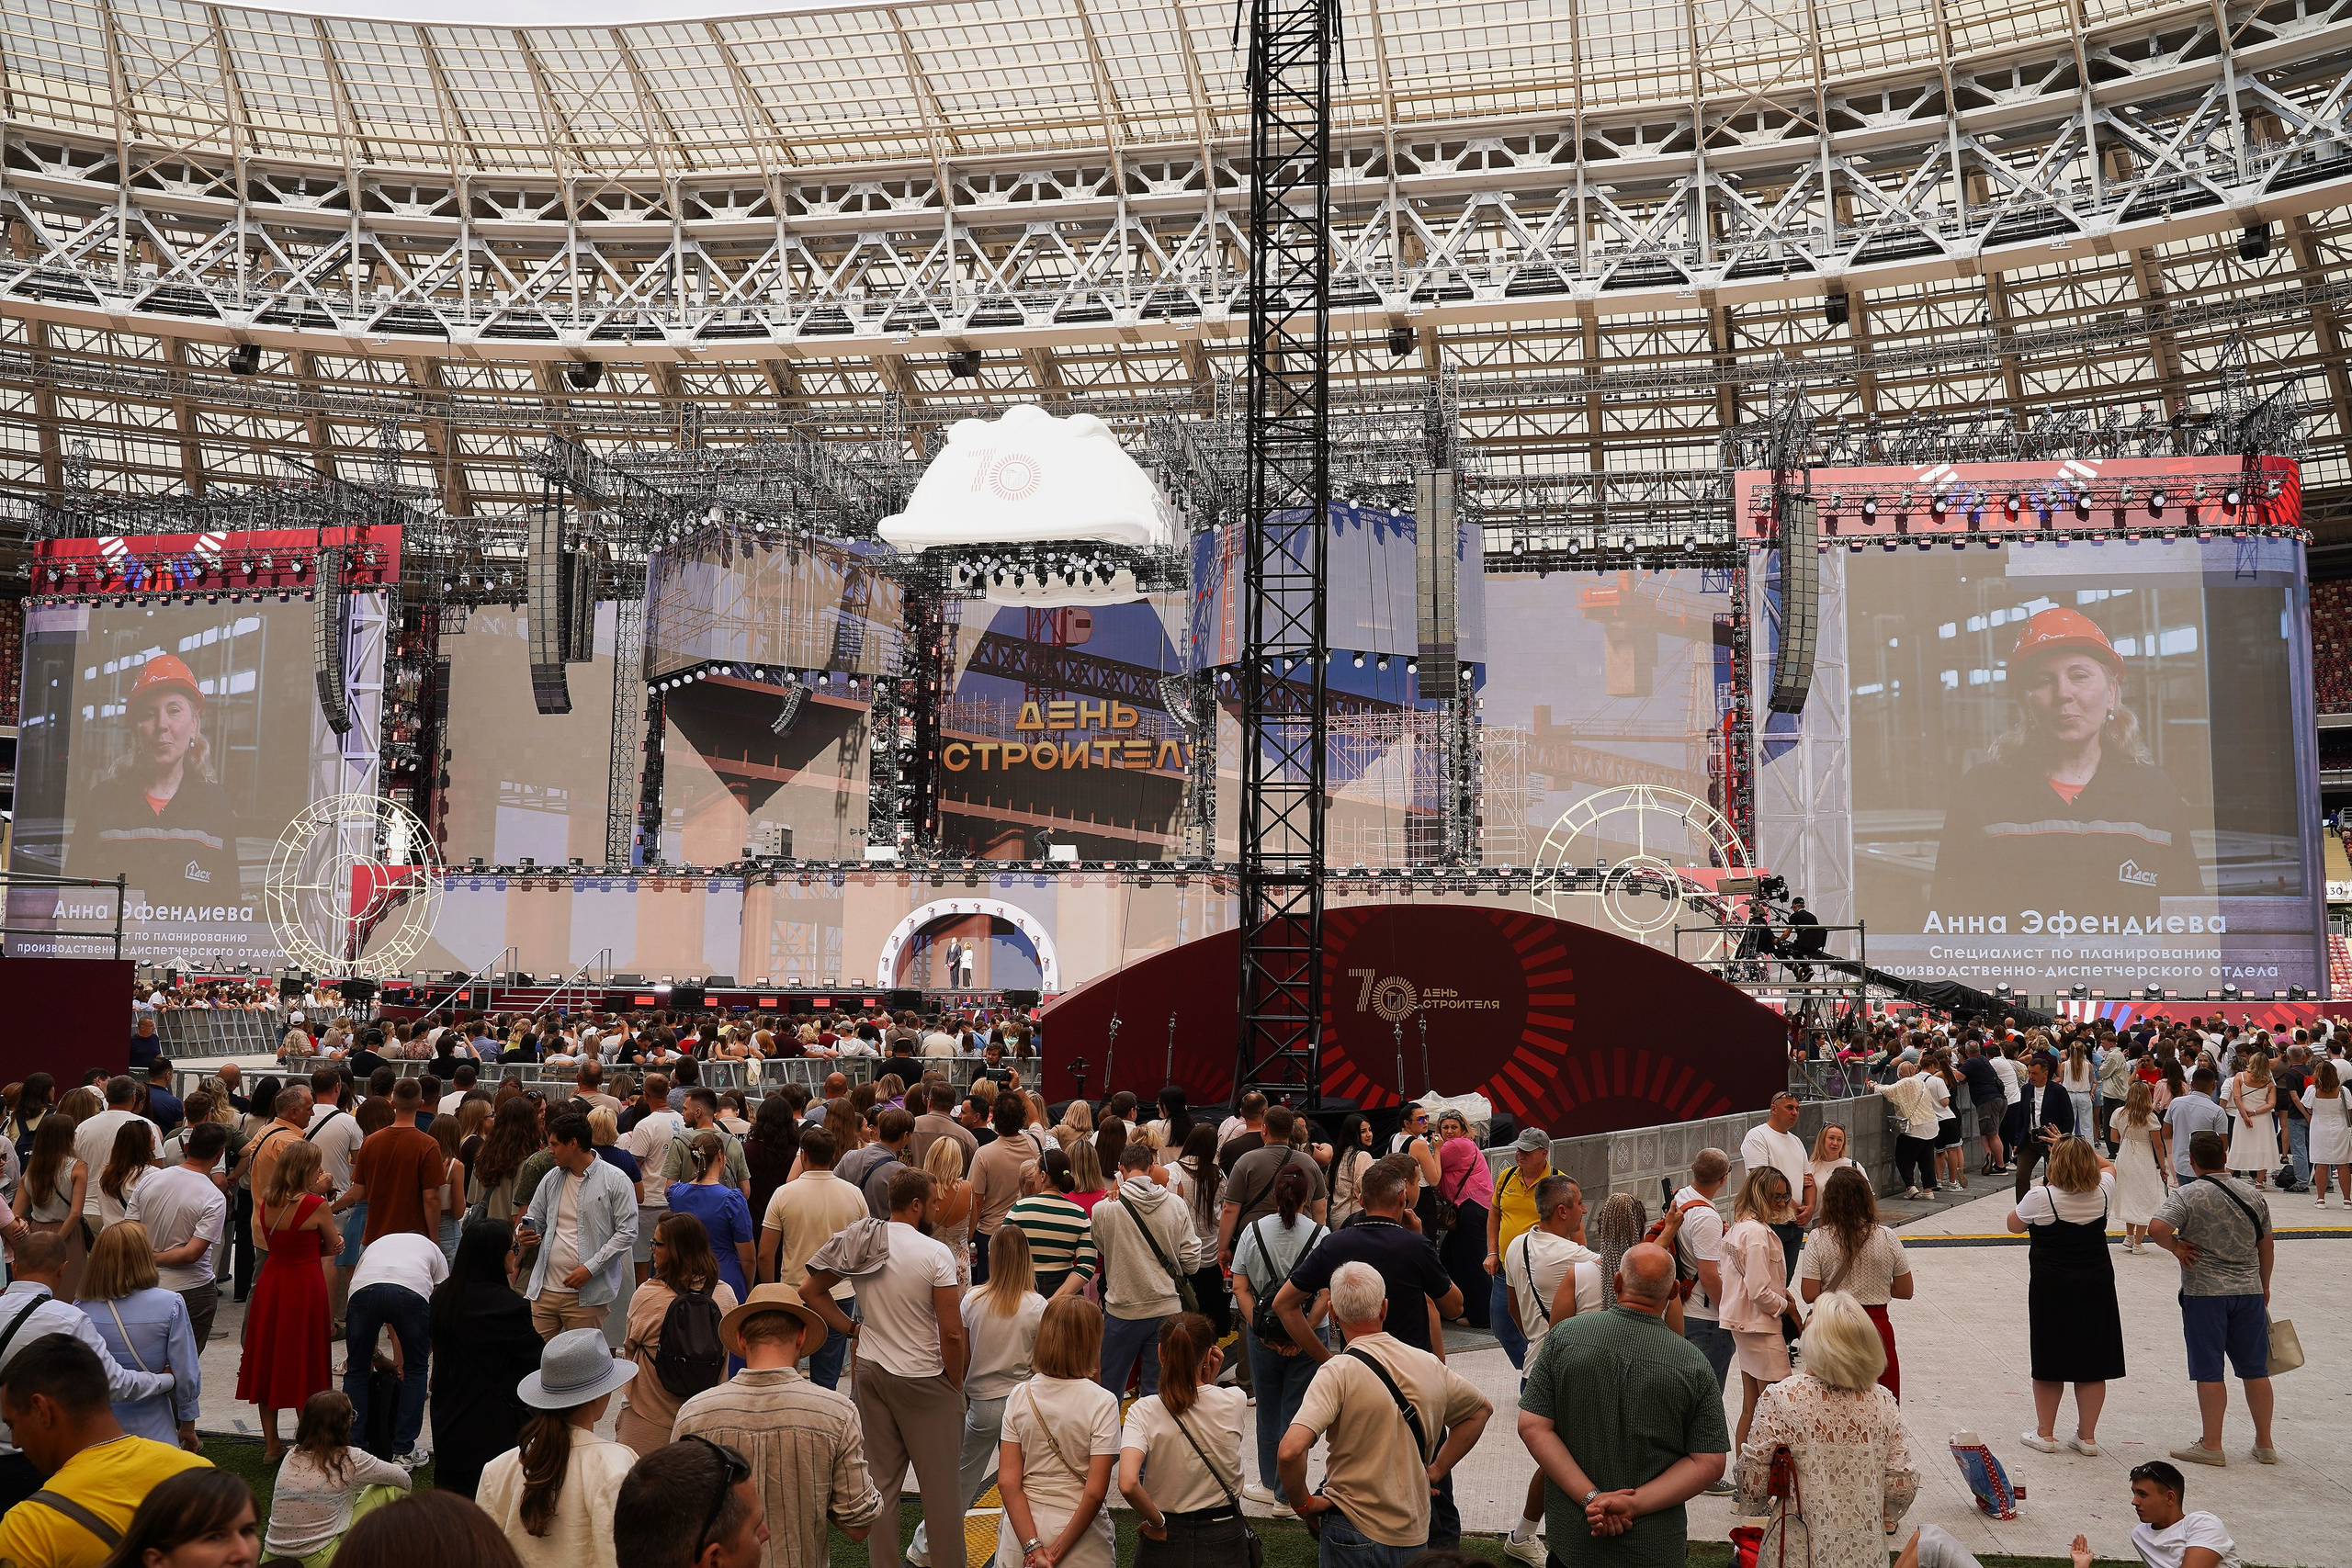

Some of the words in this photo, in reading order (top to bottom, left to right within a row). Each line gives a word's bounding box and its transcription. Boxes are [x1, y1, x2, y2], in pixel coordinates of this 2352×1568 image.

[1015, 700, 1139, 730] ДЕНЬ
[943, 739, 1213, 772] СТРОИТЕЛ
[52, 899, 108, 919] Анна
[121, 900, 254, 924] Эфендиева
[1922, 910, 2007, 934] Анна
[2019, 909, 2226, 939] Эфендиева
[135, 931, 150, 942] по
[153, 931, 248, 946] планированию
[239, 948, 285, 959] отдела
[1929, 945, 2045, 961] Специалист
[2052, 949, 2073, 959] по
[2080, 948, 2222, 962] планированию
[2210, 965, 2278, 978] отдела
[1422, 987, 1459, 998] ДЕНЬ
[1423, 999, 1500, 1010] СТРОИТЕЛЯ
